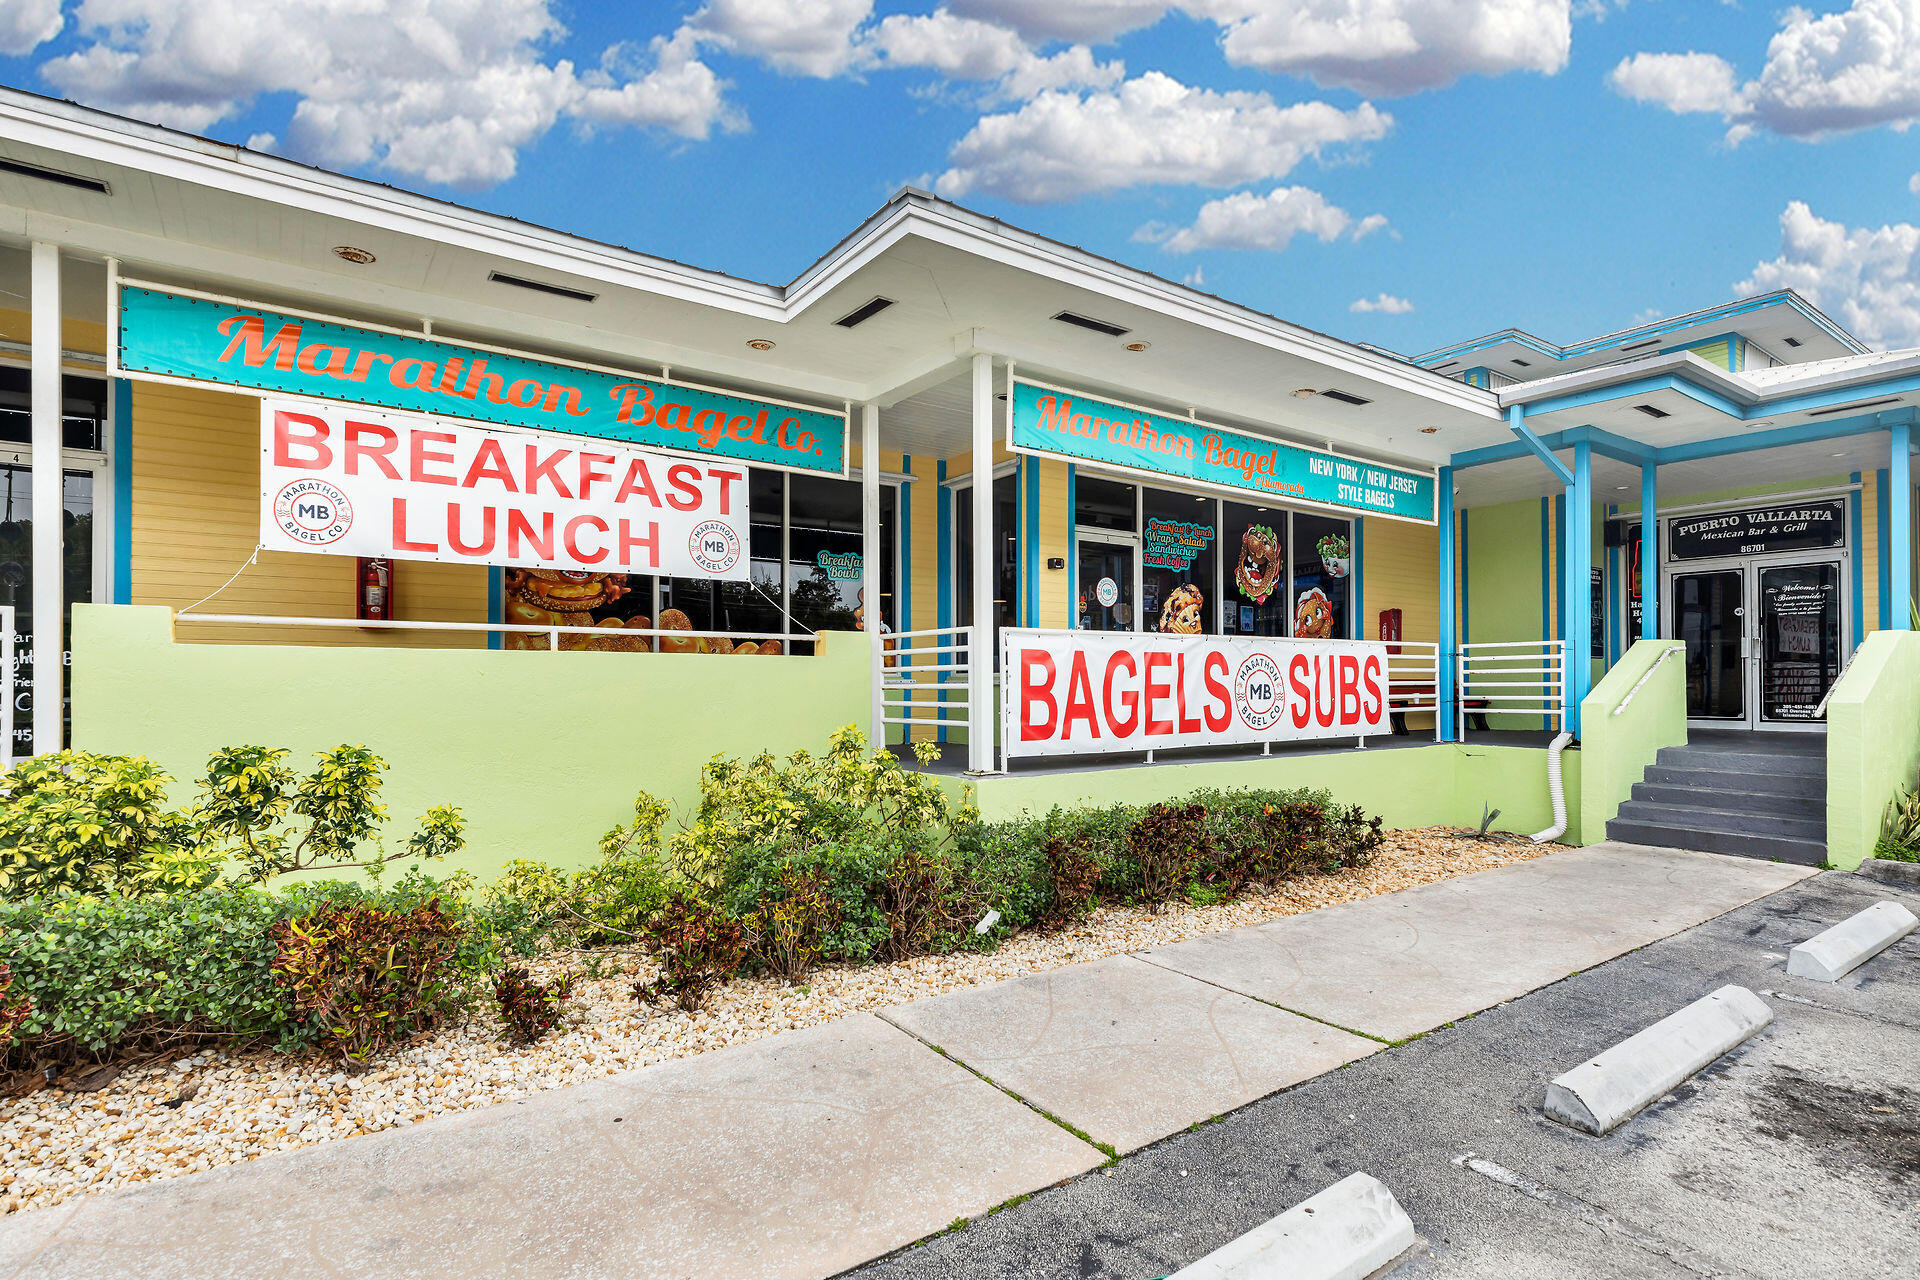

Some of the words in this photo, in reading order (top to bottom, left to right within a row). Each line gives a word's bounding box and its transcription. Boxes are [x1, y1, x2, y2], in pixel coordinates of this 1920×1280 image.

[217, 315, 590, 417] Marathon
[609, 383, 769, 448] Bagel
[777, 416, 823, 456] Co.
[1036, 395, 1197, 460] Marathon
[1202, 433, 1277, 481] Bagel
[13, 454, 20, 462] 4
[274, 410, 743, 516] BREAKFAST
[1254, 475, 1305, 494] @Islamorada
[1309, 457, 1333, 477] NEW
[1335, 462, 1358, 482] YORK
[1366, 469, 1389, 486] NEW
[1388, 474, 1418, 495] JERSEY
[283, 482, 345, 506] MARATHON
[1338, 483, 1363, 503] STYLE
[1364, 488, 1395, 509] BAGELS
[298, 503, 330, 520] MB
[285, 521, 326, 541] BAGEL
[328, 525, 343, 538] CO
[393, 497, 660, 568] LUNCH
[694, 523, 735, 542] MARATHON
[1151, 520, 1185, 535] Breakfast
[1193, 526, 1213, 538] Lunch
[1678, 516, 1740, 537] PUERTO
[1746, 510, 1833, 523] VALLARTA
[1701, 529, 1745, 541] Mexican
[1748, 527, 1765, 536] Bar
[1769, 525, 1779, 534] &
[1783, 522, 1808, 533] Grill
[704, 540, 725, 553] MB
[1147, 531, 1174, 545] Wraps
[1179, 534, 1205, 548] Salads
[1740, 543, 1765, 553] 86701
[1149, 543, 1196, 557] Sandwiches
[695, 554, 722, 570] BAGEL
[722, 556, 734, 568] CO
[1144, 553, 1165, 565] Fresh
[1166, 555, 1188, 569] Coffee
[829, 566, 859, 579] Bowls
[1102, 588, 1112, 596] MB
[1239, 658, 1279, 682] MARATHON
[1020, 649, 1233, 742] BAGELS
[1289, 653, 1382, 729] SUBS
[1249, 683, 1272, 700] MB
[1241, 705, 1268, 726] BAGEL
[1269, 704, 1281, 720] CO
